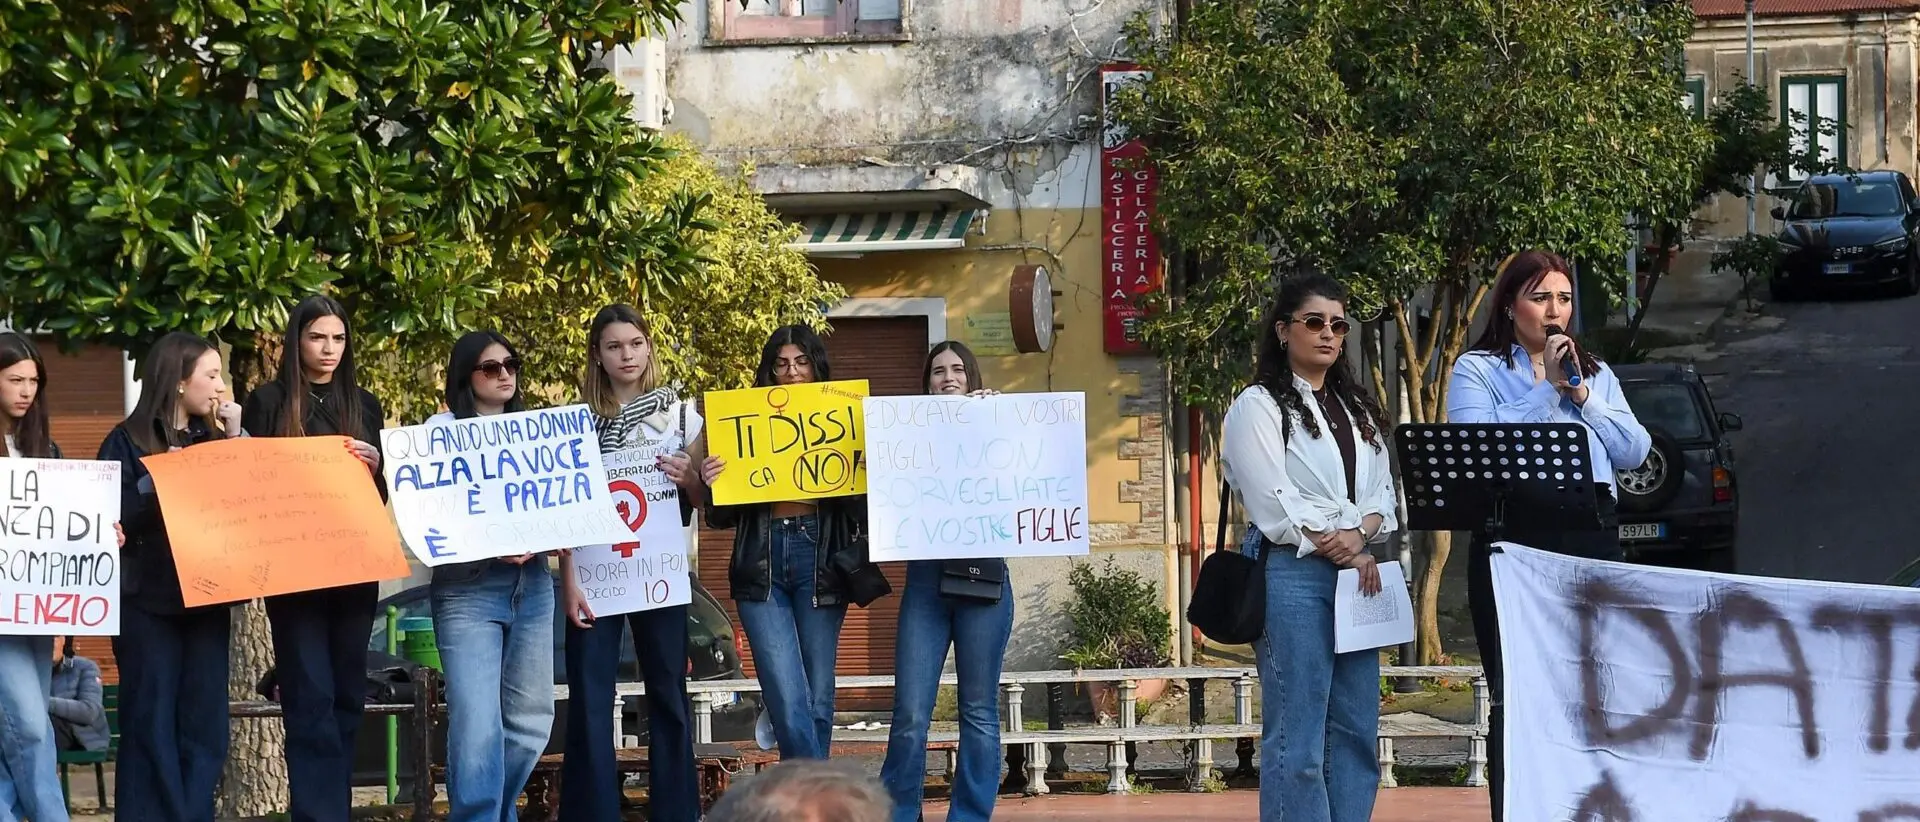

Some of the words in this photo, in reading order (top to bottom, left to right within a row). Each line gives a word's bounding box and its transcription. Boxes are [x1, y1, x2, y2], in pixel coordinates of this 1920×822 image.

[1134, 170, 1149, 285] GELATERIA
[525, 408, 594, 441] DONNA
[865, 399, 972, 430] EDUCATE
[1015, 398, 1081, 426] VOSTRI
[719, 413, 755, 459] TI
[769, 406, 857, 454] DISSI
[395, 457, 473, 491] ALZA
[483, 449, 520, 480] LA
[521, 437, 590, 474] VOCE
[955, 437, 1044, 471] NON
[10, 469, 39, 501] LA
[606, 463, 665, 480] IBERAZION
[750, 466, 776, 489] CA
[468, 484, 486, 515] È
[505, 472, 592, 513] PAZZA
[876, 475, 1074, 508] SORVEGLIATE
[68, 511, 101, 544] DI
[424, 527, 457, 558] È
[878, 515, 909, 551] LE
[921, 513, 1013, 546] VOSTRE
[1016, 506, 1083, 546] FIGLIE
[1622, 525, 1658, 538] 597LR
[578, 562, 629, 584] D'ORA
[637, 559, 652, 578] IN
[661, 553, 683, 573] POI
[586, 585, 627, 600] DECIDO
